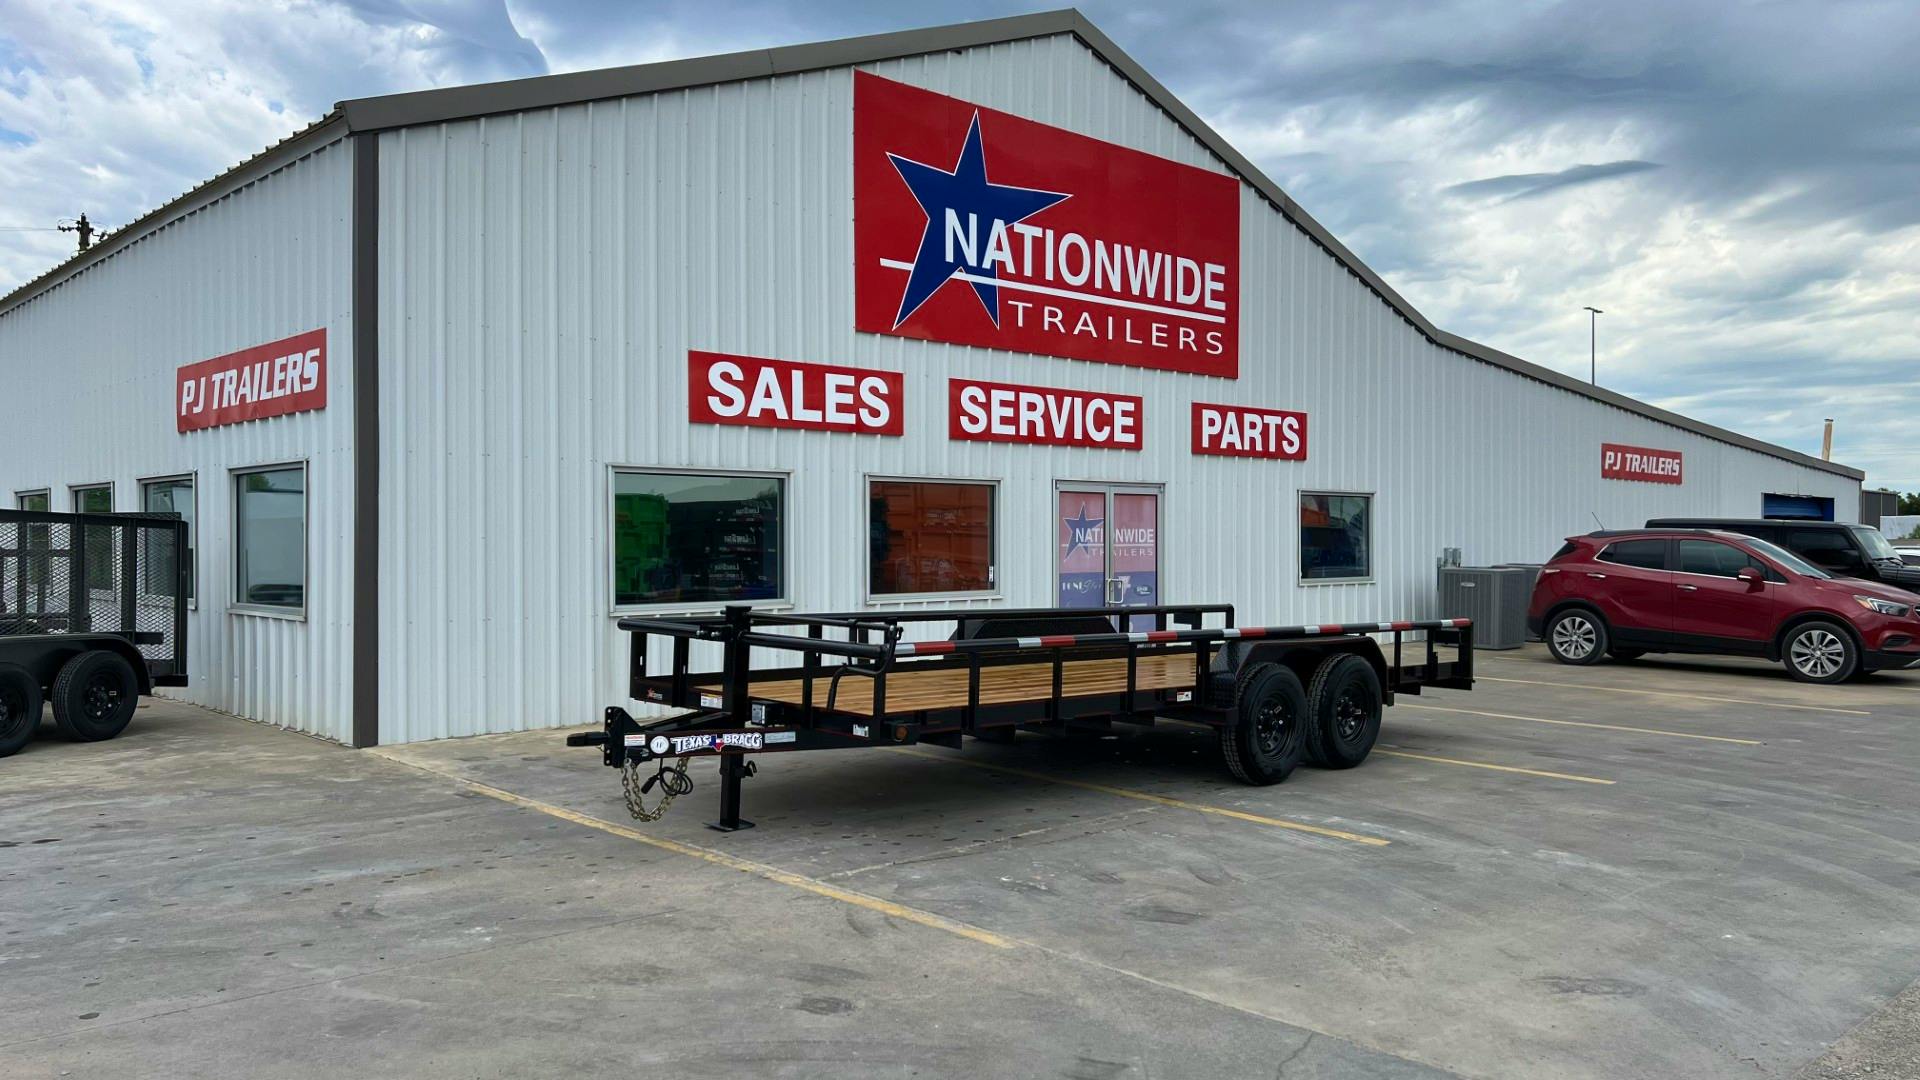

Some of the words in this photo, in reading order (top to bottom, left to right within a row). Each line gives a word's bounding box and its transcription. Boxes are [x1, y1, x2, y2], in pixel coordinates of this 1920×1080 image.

[945, 208, 1226, 310] NATIONWIDE
[1007, 300, 1224, 355] TRAILERS
[181, 377, 205, 416] PJ
[212, 348, 320, 410] TRAILERS
[707, 361, 890, 427] SALES
[960, 385, 1135, 443] SERVICE
[1201, 410, 1300, 453] PARTS
[1604, 450, 1621, 470] PJ
[1625, 453, 1680, 476] TRAILERS
[1075, 528, 1154, 543] NATINWIDE
[670, 735, 711, 754] TEXAS
